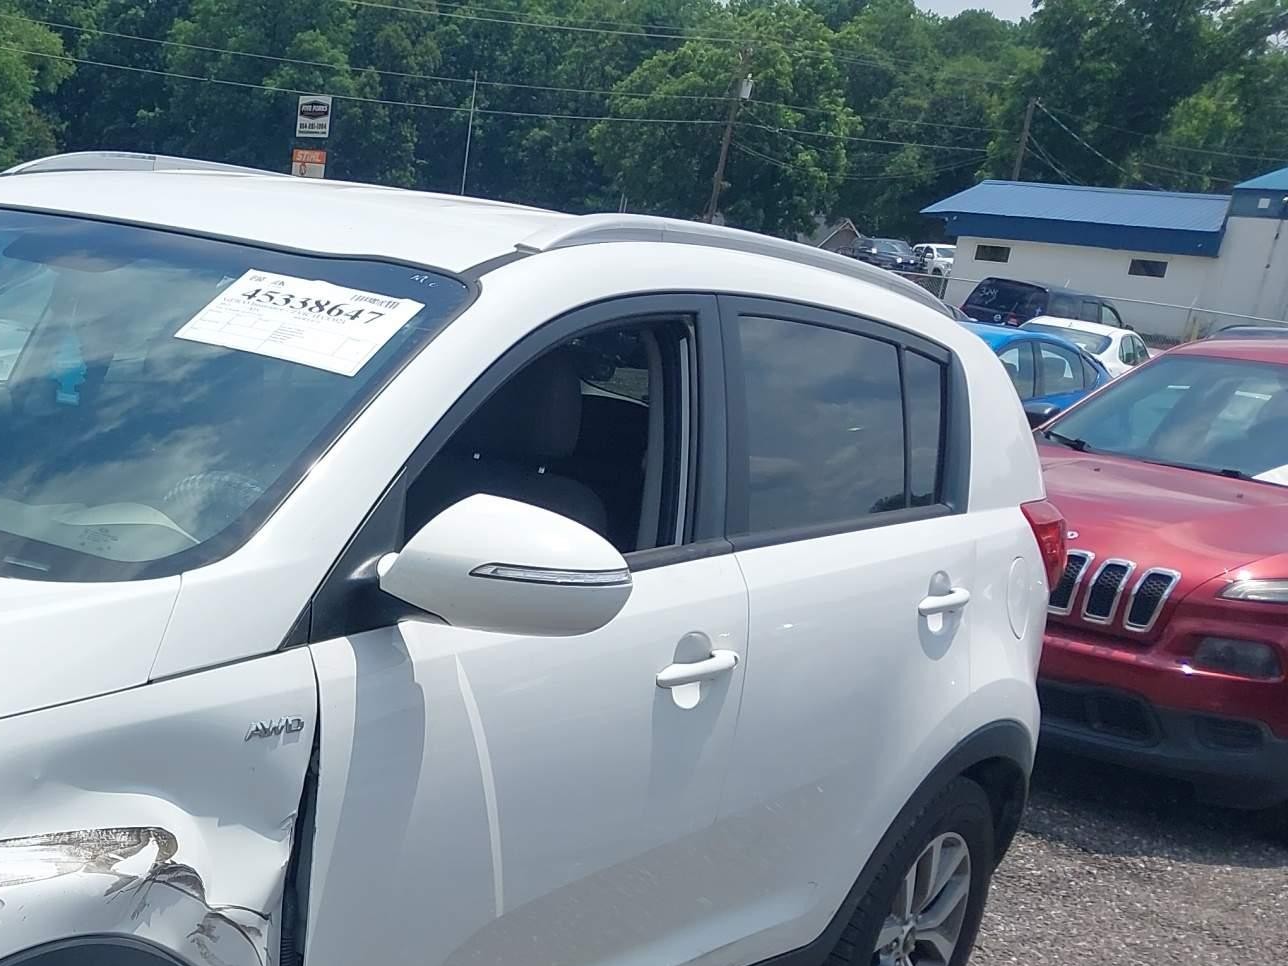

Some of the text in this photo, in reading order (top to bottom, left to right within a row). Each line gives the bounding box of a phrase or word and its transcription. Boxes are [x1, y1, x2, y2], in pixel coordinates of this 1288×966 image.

[295, 151, 322, 163] STIHL
[242, 288, 385, 324] 45338647
[244, 718, 305, 742] AWD
